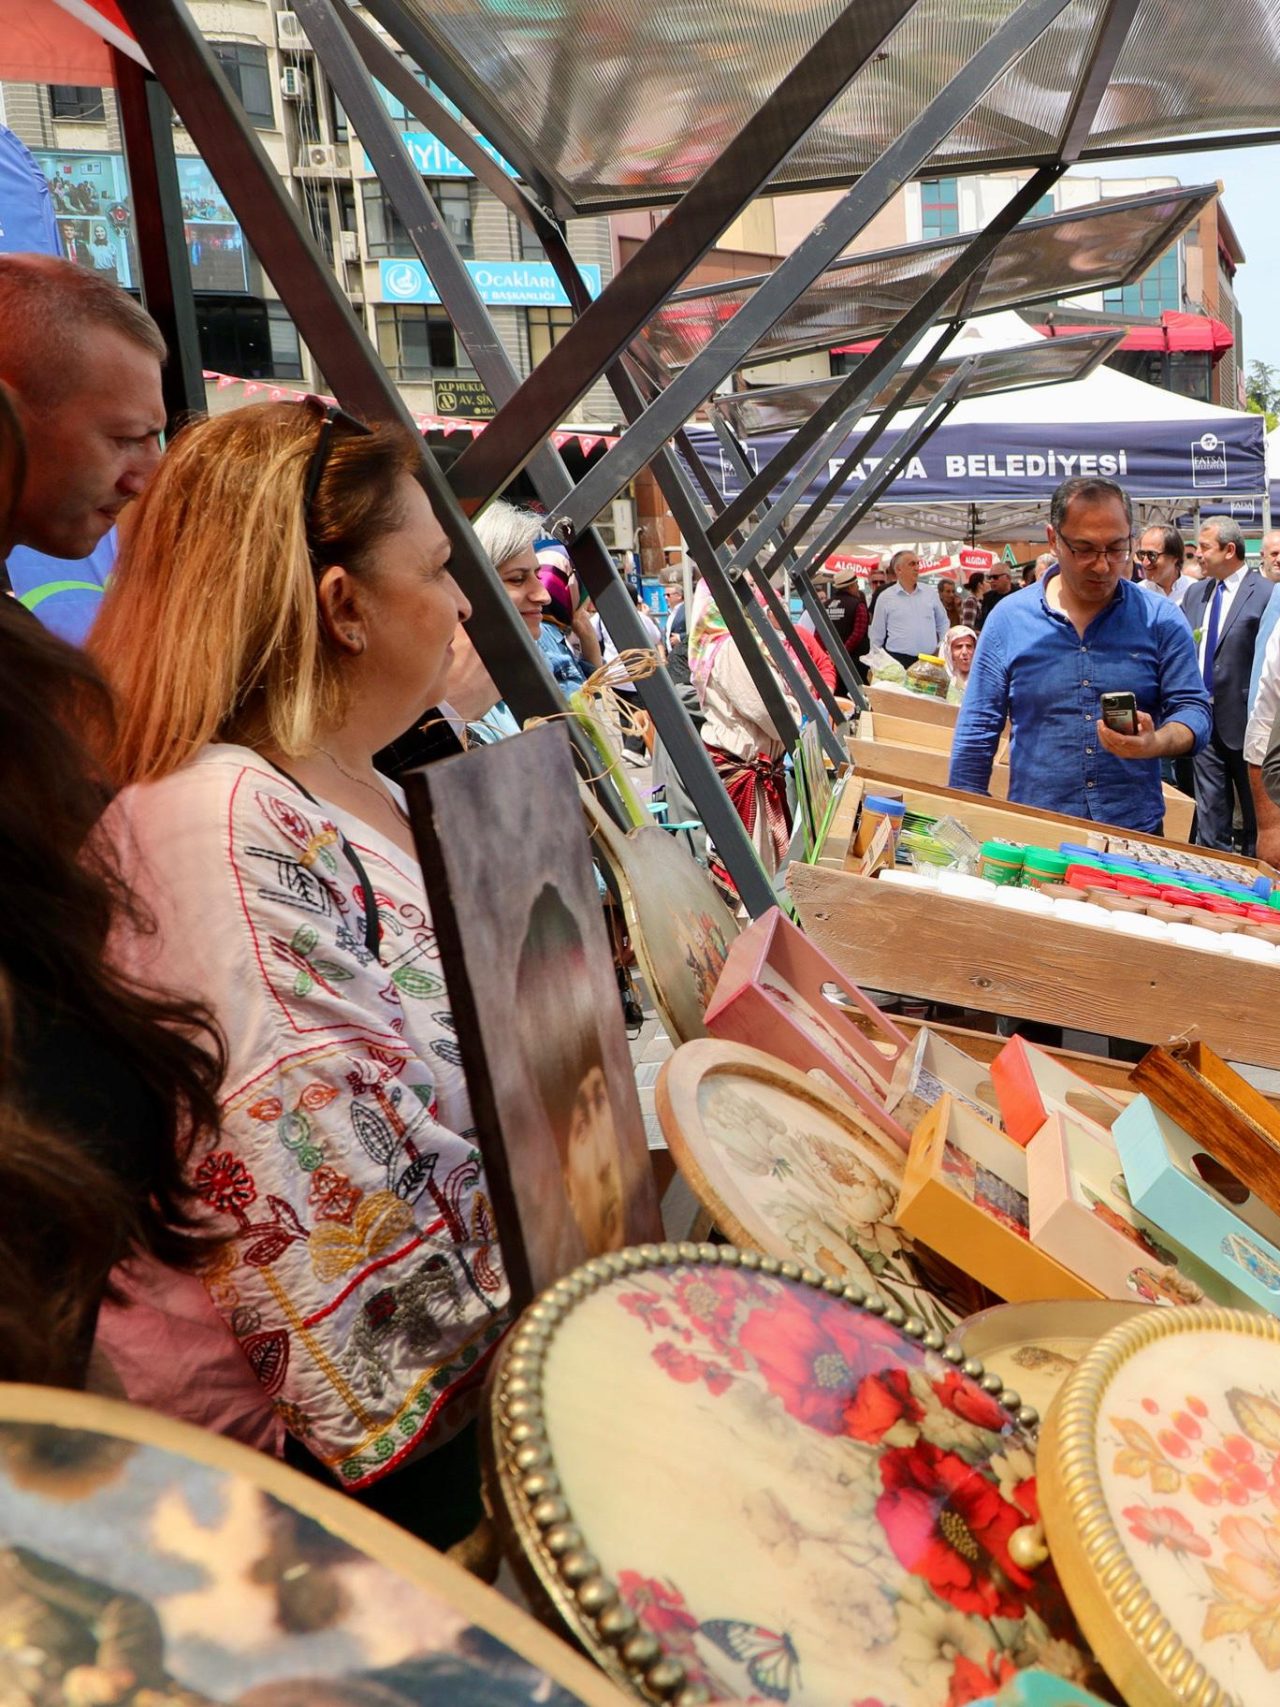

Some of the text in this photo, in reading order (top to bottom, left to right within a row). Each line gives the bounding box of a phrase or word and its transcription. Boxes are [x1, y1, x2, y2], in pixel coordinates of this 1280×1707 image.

[492, 290, 556, 301] BAŞKANLIĞI
[438, 383, 455, 392] ALP
[459, 395, 475, 405] AV.
[946, 449, 1128, 477] BELEDİYESİ
[1194, 456, 1225, 465] FATSA
[965, 556, 988, 566] ALGIDA
